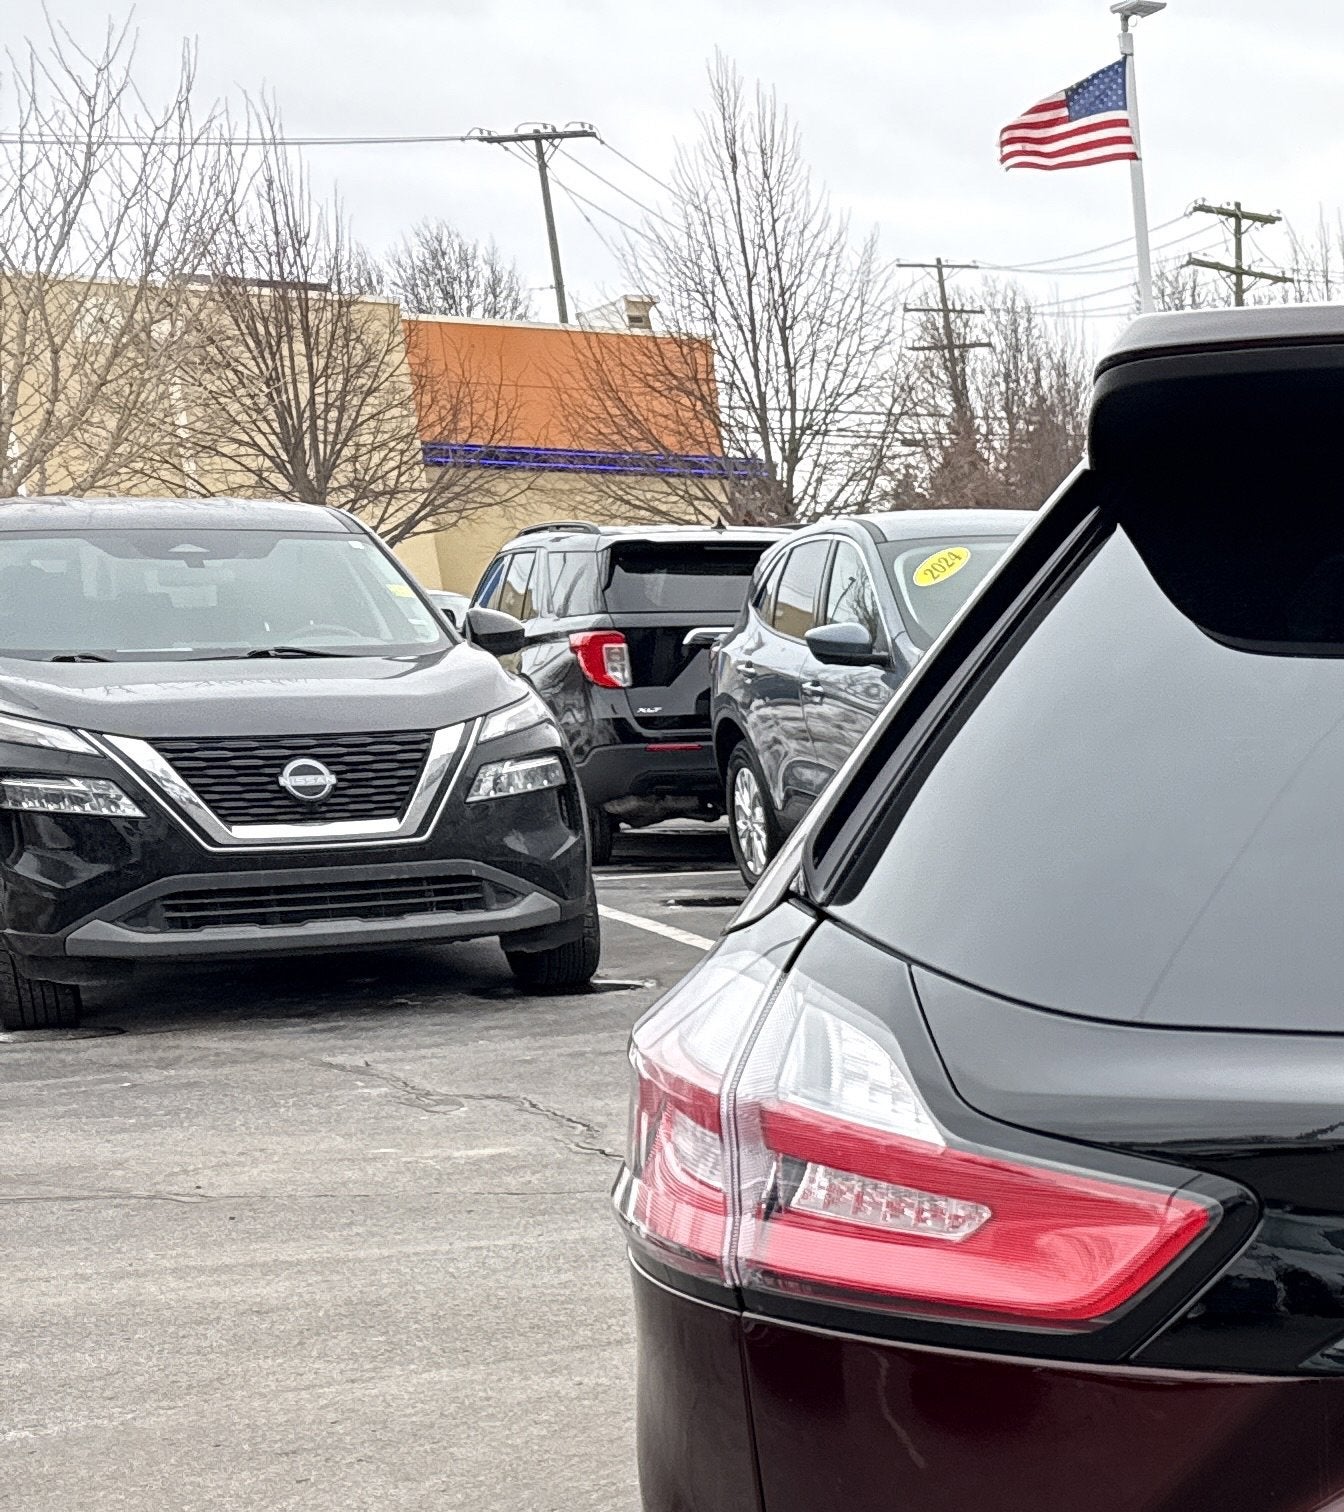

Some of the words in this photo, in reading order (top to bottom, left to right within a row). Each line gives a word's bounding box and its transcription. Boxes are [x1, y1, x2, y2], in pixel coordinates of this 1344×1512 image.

[924, 551, 962, 580] 2024
[636, 706, 663, 714] XLT
[279, 774, 336, 786] NISSAN
